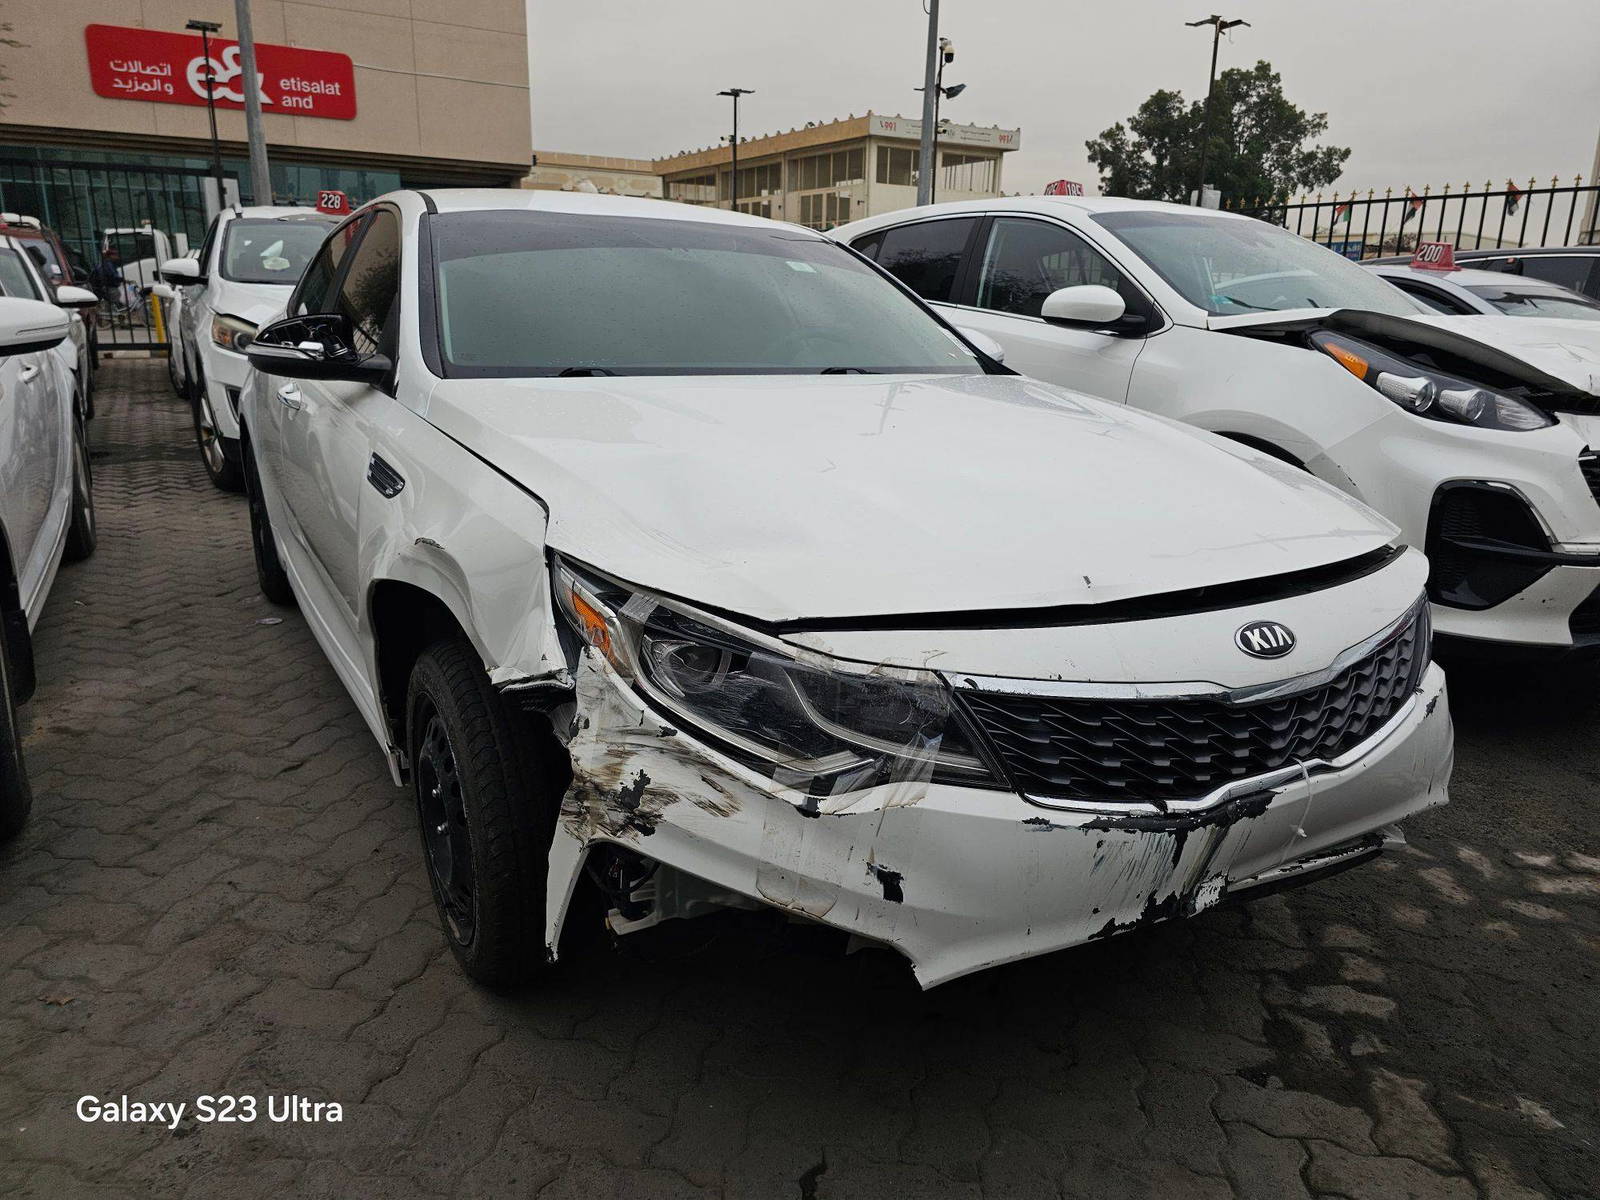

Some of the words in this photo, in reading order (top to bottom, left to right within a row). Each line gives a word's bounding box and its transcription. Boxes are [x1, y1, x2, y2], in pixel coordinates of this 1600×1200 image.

[110, 60, 171, 76] اتصالات
[280, 77, 341, 96] etisalat
[282, 95, 313, 109] and
[321, 193, 341, 209] 228
[1416, 244, 1443, 263] 200
[1243, 625, 1293, 651] KIA
